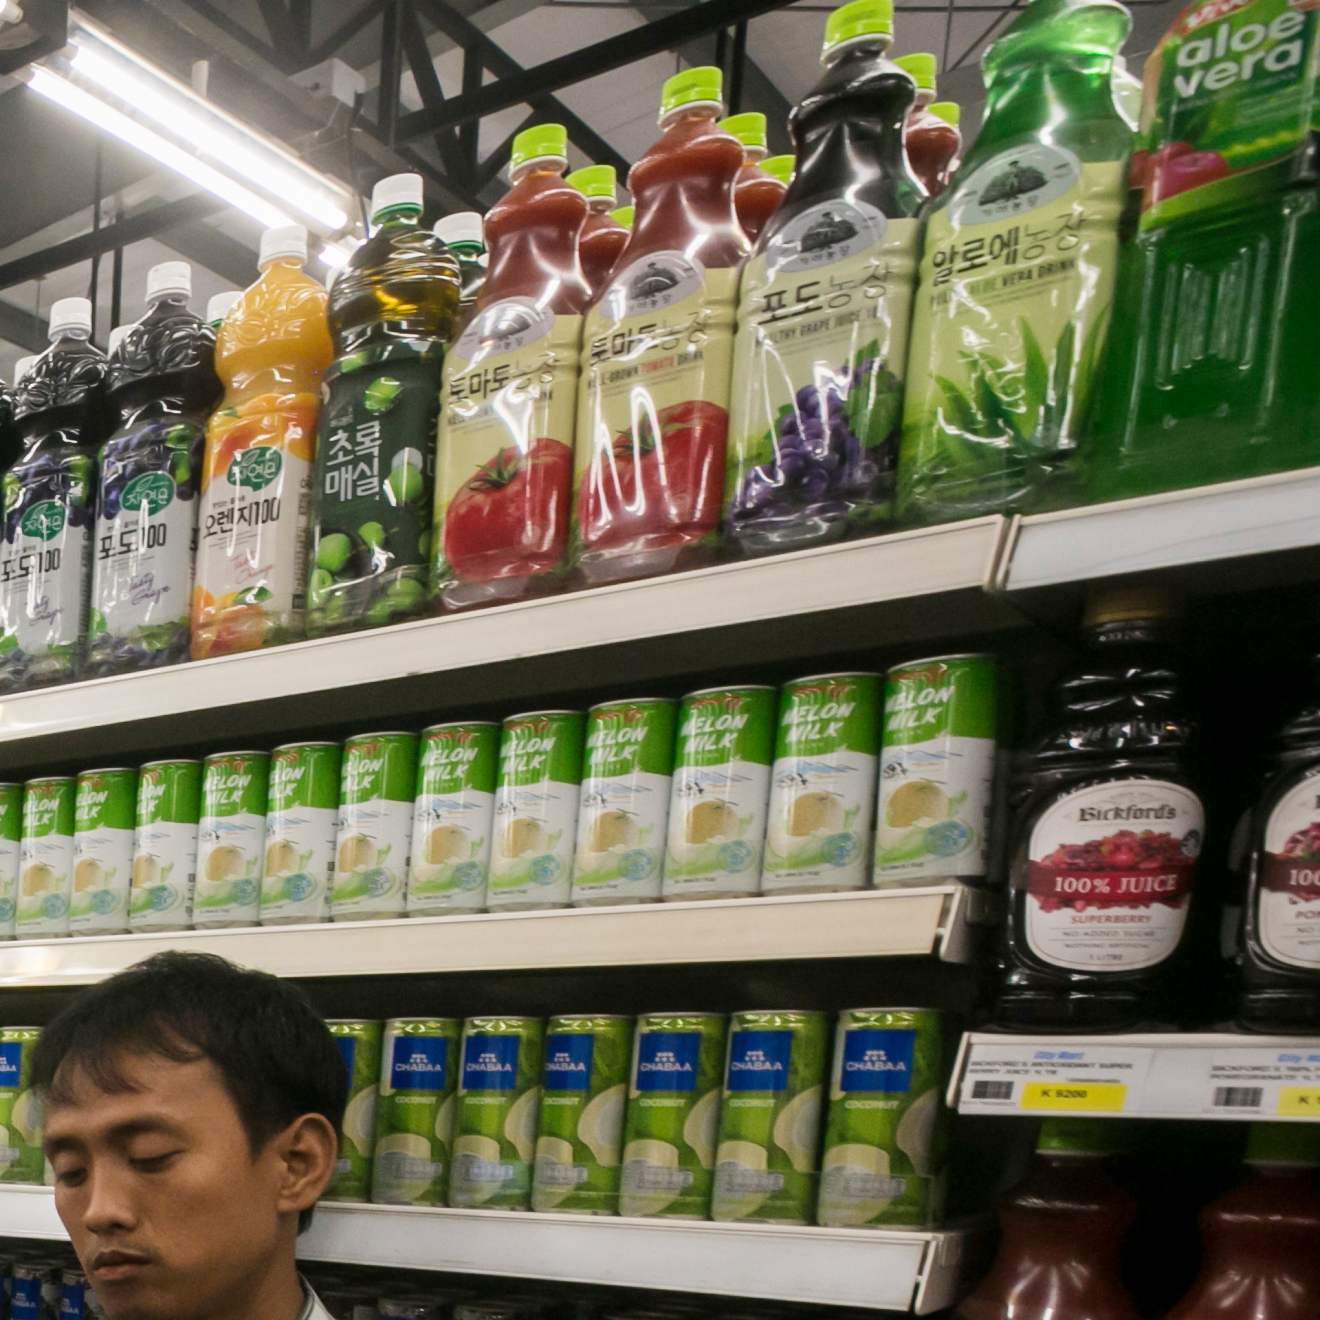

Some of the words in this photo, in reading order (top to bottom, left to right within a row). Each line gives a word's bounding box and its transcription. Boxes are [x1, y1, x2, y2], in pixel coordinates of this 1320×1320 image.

[1177, 12, 1305, 67] aloe
[1174, 40, 1303, 97] vera
[758, 261, 893, 325] 포도농장
[326, 420, 382, 467] 초록
[324, 460, 382, 502] 매실
[1054, 876, 1111, 894] 100%
[1116, 874, 1179, 894] JUICE
[1071, 913, 1152, 925] SUPERBERRY
